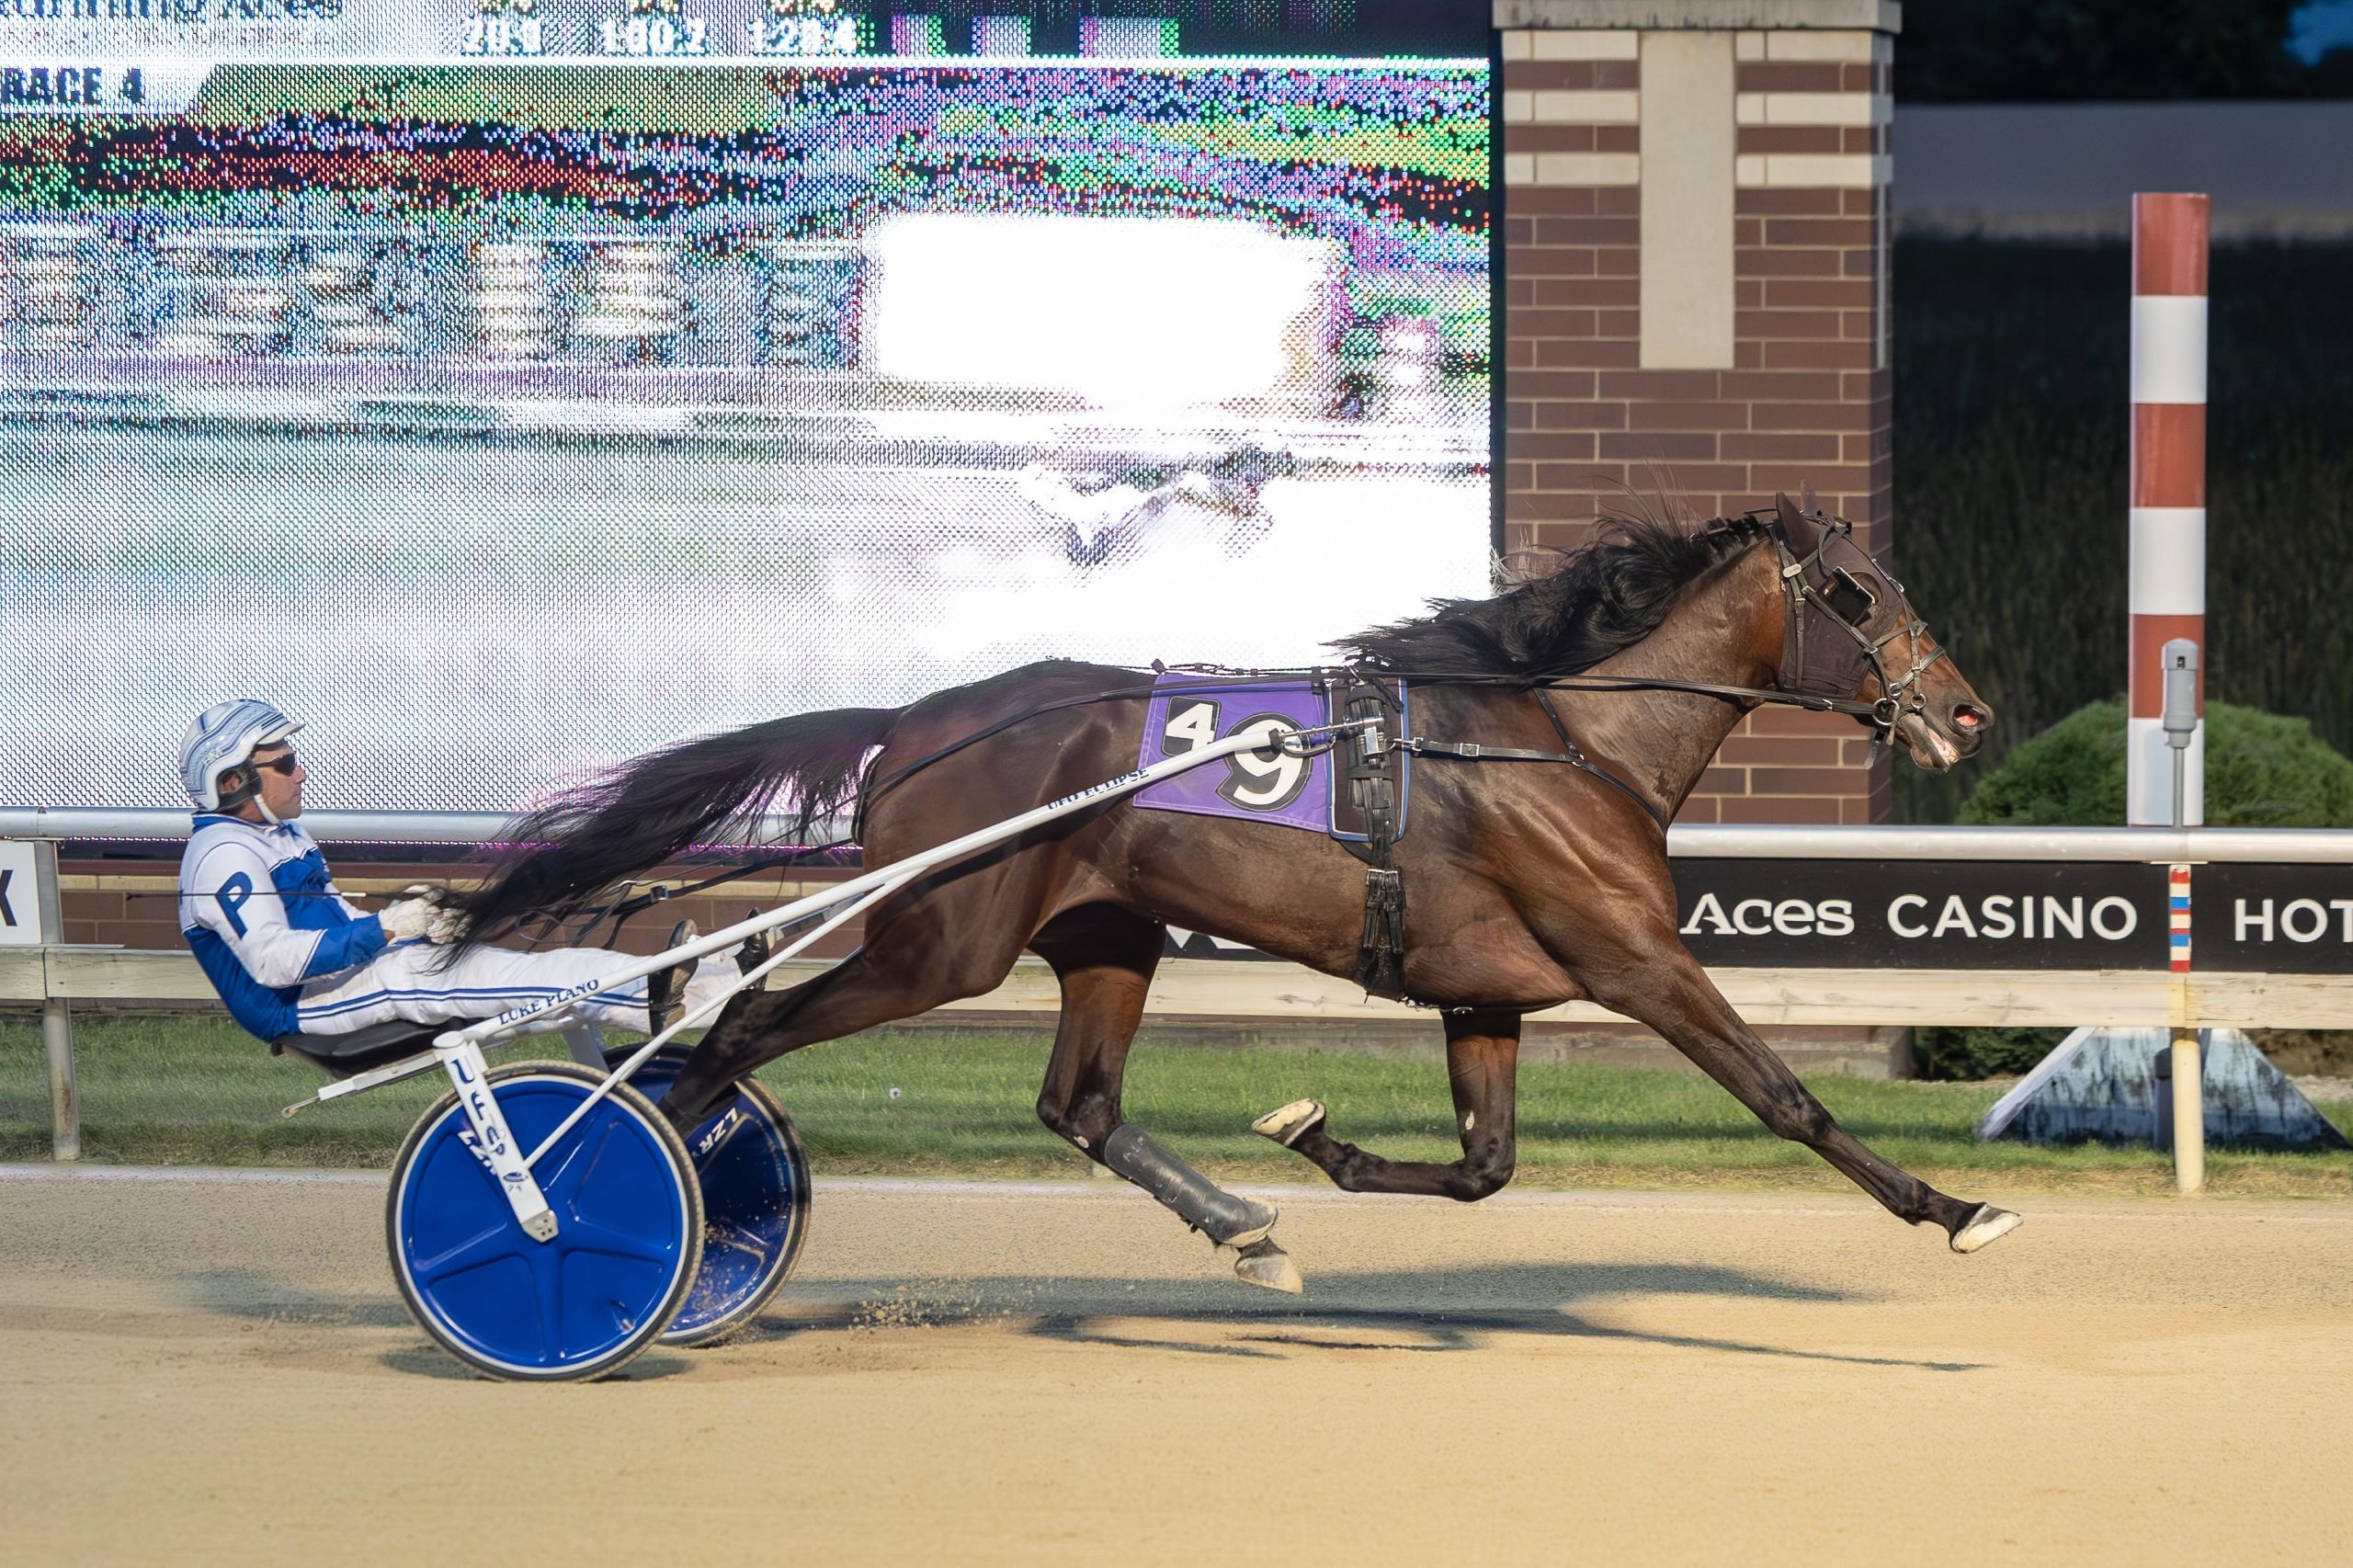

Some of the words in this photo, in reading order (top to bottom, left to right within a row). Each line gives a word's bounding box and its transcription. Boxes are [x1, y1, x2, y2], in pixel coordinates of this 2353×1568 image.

[1, 67, 101, 105] RACE
[120, 67, 142, 104] 4
[1165, 700, 1217, 753] 4
[1229, 717, 1307, 808] 9
[214, 870, 253, 942] P
[1679, 892, 1855, 937] Aces
[1887, 894, 2138, 940] CASINO
[2234, 898, 2353, 943] HOT
[498, 1001, 542, 1026] LUKE
[545, 978, 599, 1008] PLANO
